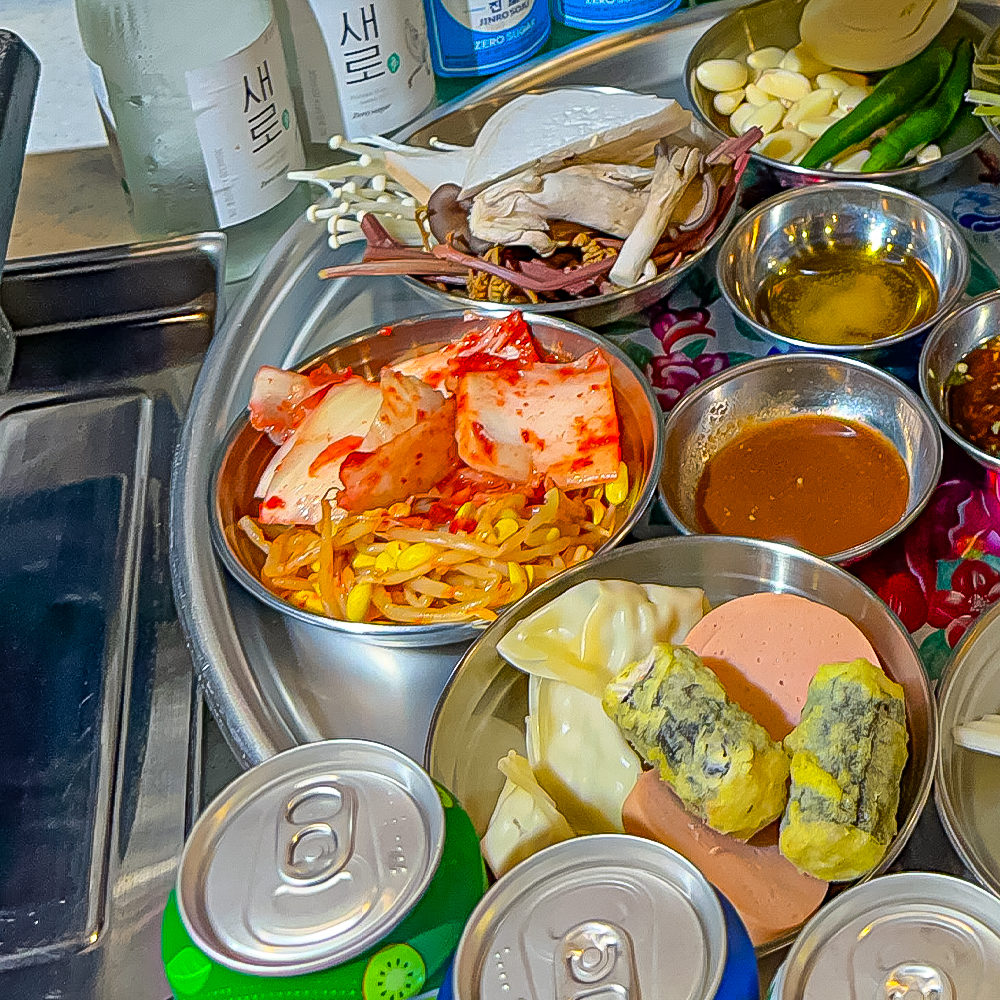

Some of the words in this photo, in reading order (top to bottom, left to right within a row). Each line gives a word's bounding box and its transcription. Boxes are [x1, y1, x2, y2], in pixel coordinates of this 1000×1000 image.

[340, 2, 386, 86] 새로
[474, 34, 506, 51] ZERO
[506, 18, 536, 41] SUGAR
[243, 60, 283, 154] 새로
